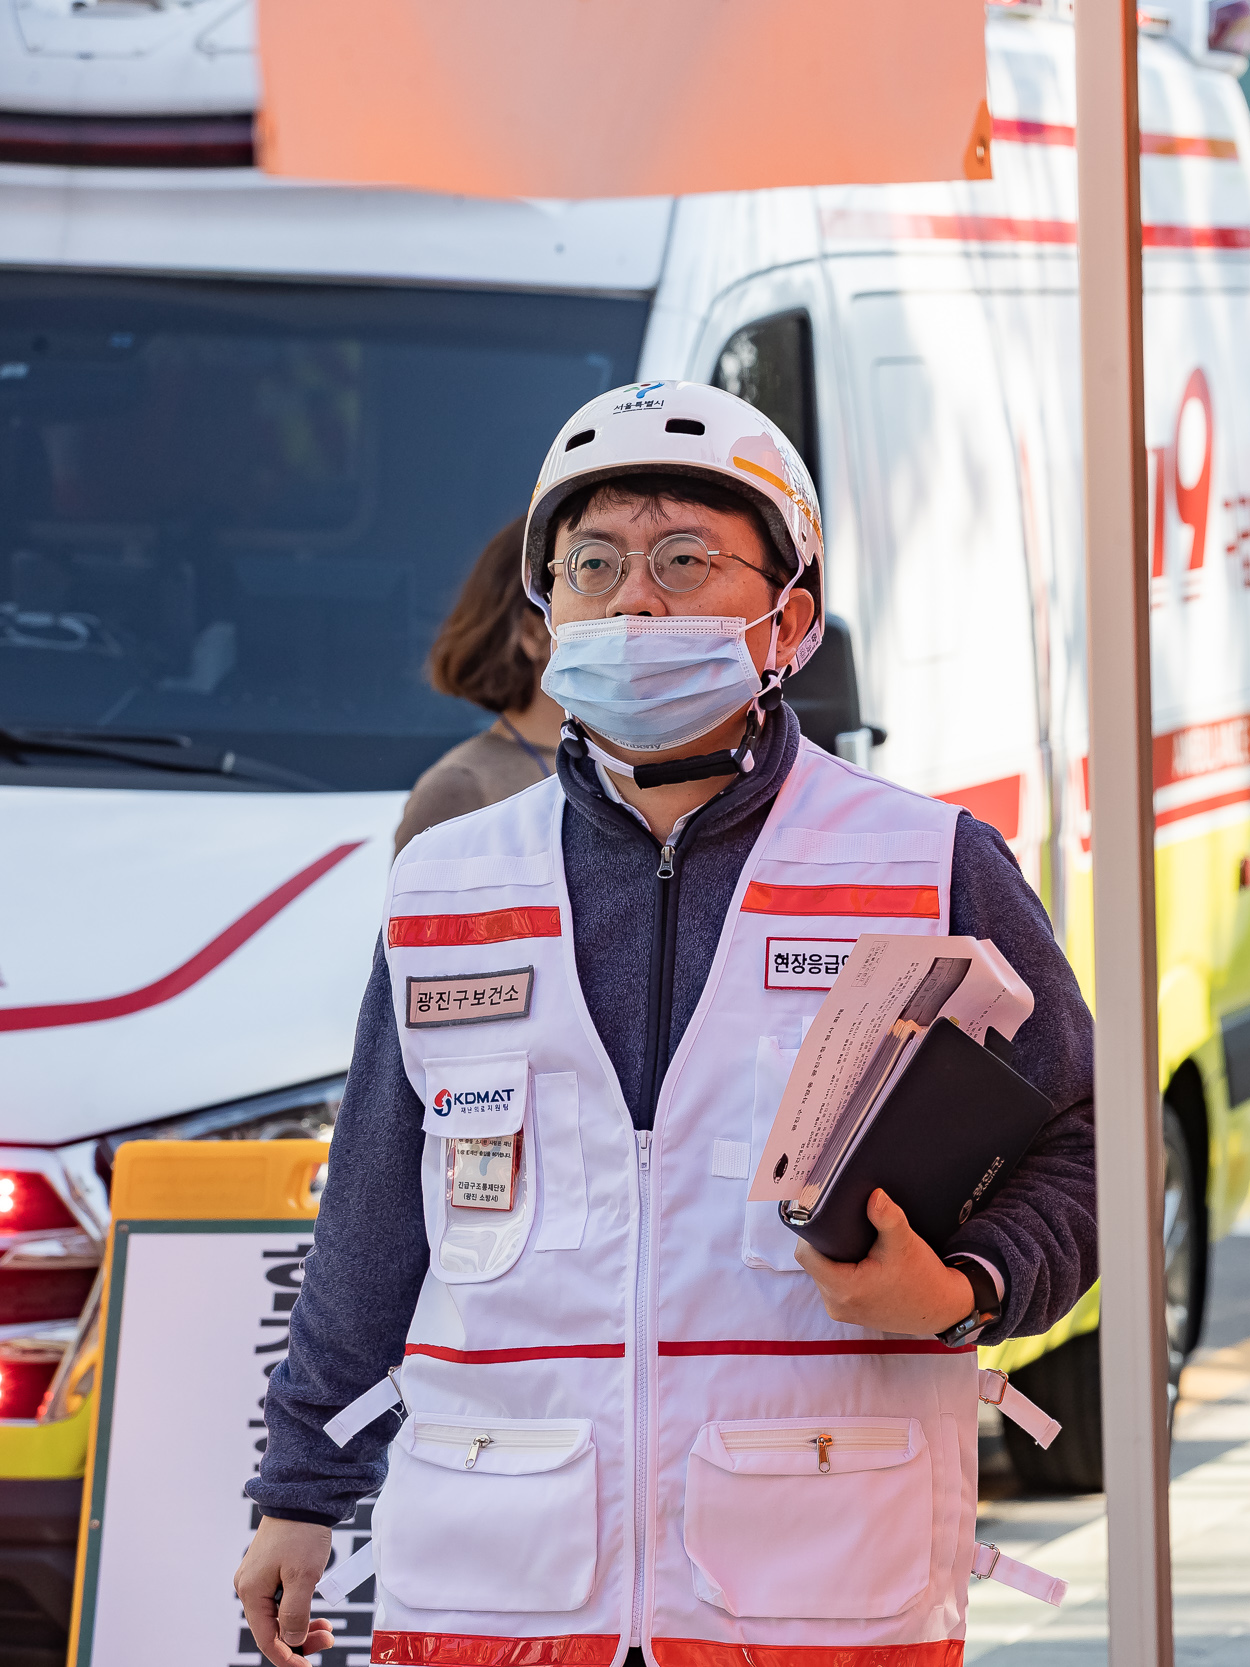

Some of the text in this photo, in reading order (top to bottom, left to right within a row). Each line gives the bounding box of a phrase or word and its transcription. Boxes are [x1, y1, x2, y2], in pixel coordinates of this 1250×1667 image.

[613, 400, 664, 411] 서울특별시
[774, 953, 849, 974] 현장응급
[417, 984, 519, 1012] 광진구보건소
[454, 1088, 515, 1105] KDMAT
[460, 1104, 509, 1114] 재난의료지원팀
[791, 1108, 803, 1132] 광진구
[458, 1181, 506, 1192] 긴급구조통제단장
